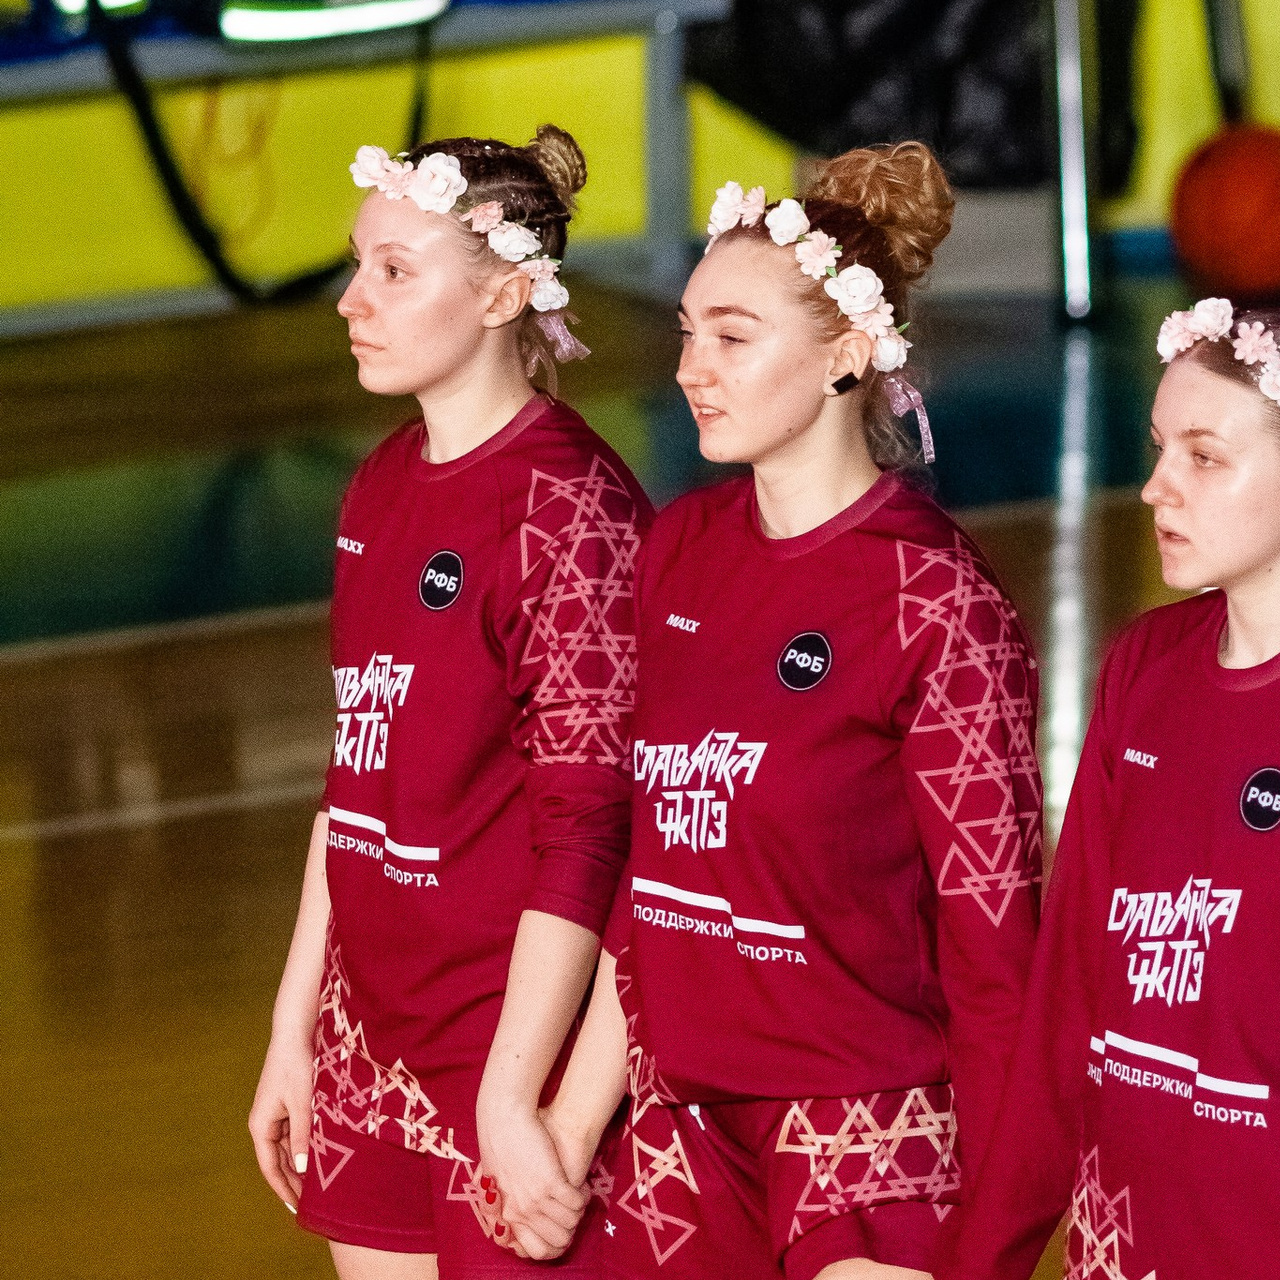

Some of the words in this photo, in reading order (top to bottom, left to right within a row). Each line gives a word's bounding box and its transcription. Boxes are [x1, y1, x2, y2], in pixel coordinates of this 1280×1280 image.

[424, 568, 459, 592] РФБ
[666, 613, 701, 634] MAXX
[784, 649, 825, 674] РФБ
[633, 727, 768, 800] СЛАВЯНКА
[1123, 748, 1158, 769] MAXX
[383, 862, 440, 888] СПОРТА
[1106, 873, 1243, 950] СЛАВЯНКА
[633, 903, 735, 940] ПОДДЕРЖКИ
[736, 941, 808, 965] СПОРТА
[1103, 1058, 1194, 1100] ПОДДЕРЖКИ
[1193, 1100, 1268, 1128] СПОРТА
